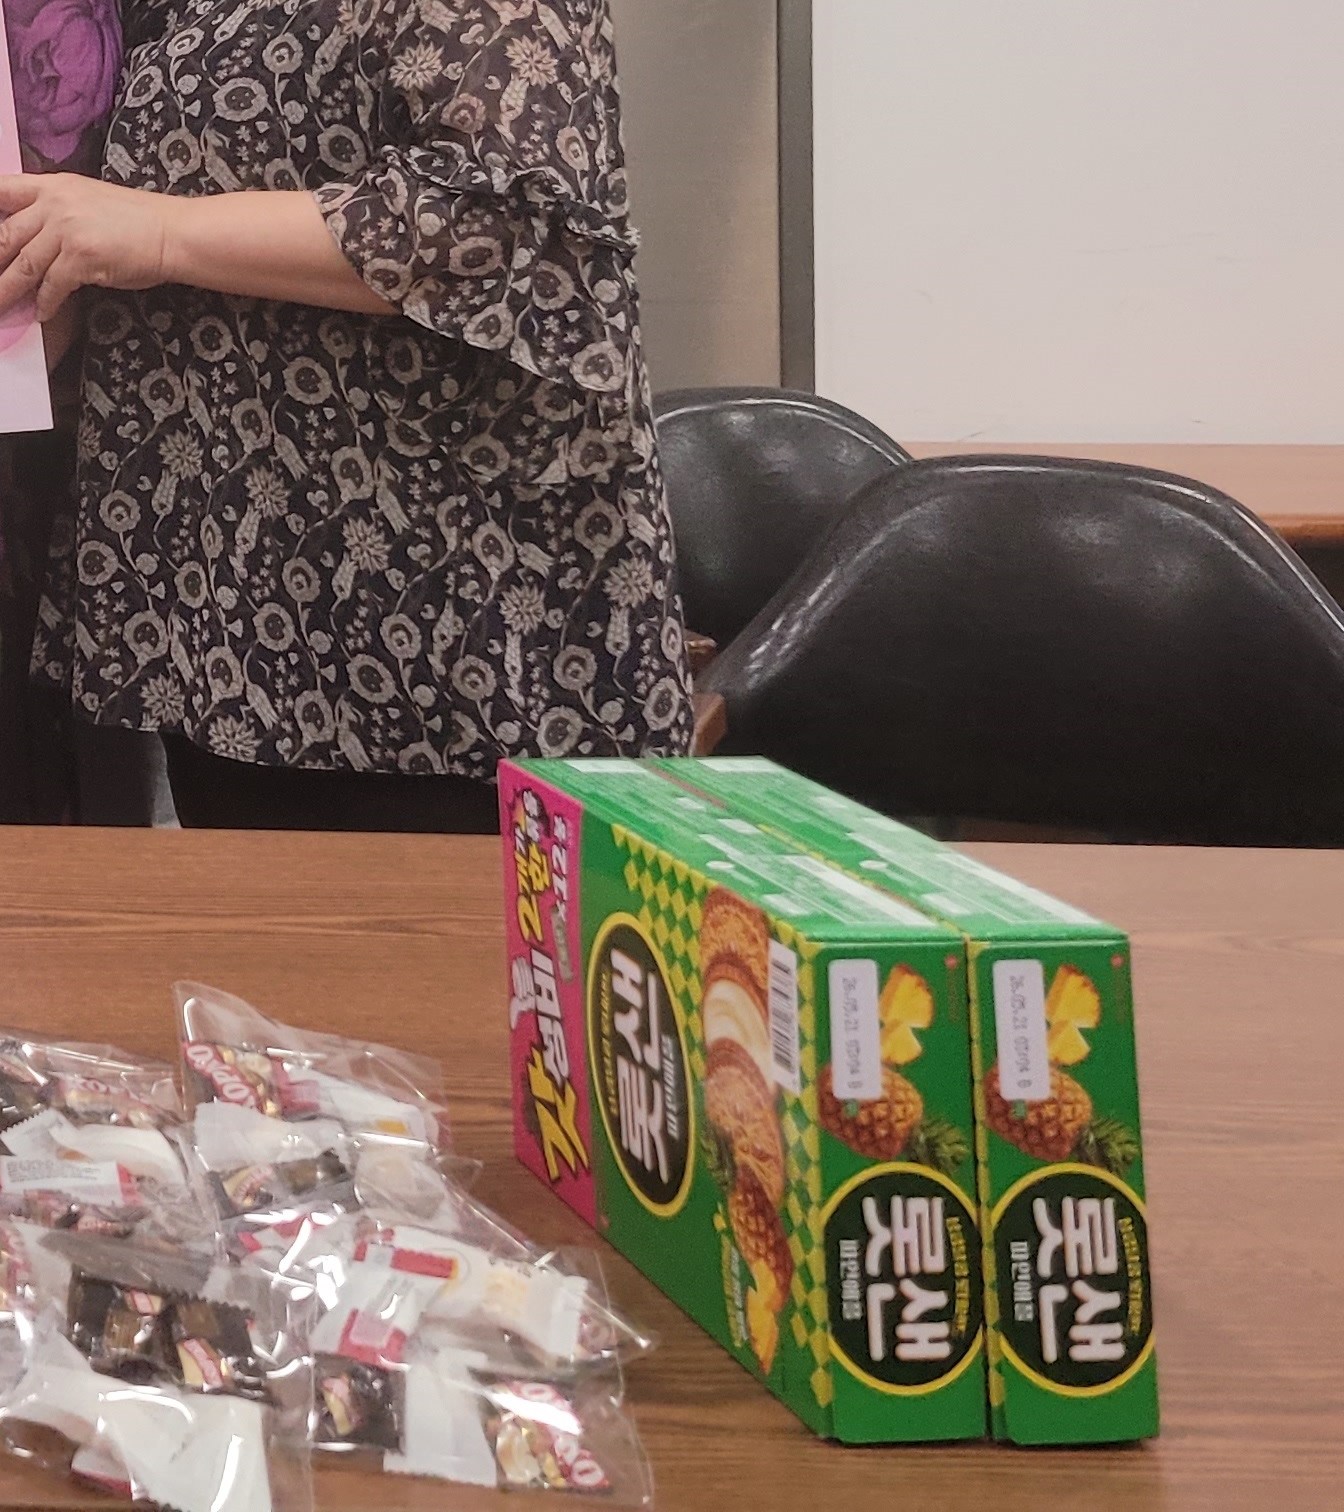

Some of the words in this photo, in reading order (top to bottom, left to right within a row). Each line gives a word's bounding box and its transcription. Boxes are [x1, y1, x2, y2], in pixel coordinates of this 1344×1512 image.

[527, 948, 589, 1184] 갓성비
[611, 947, 668, 1184] 롯샌
[863, 1195, 952, 1362] 롯샌
[1033, 1196, 1126, 1364] 롯샌
